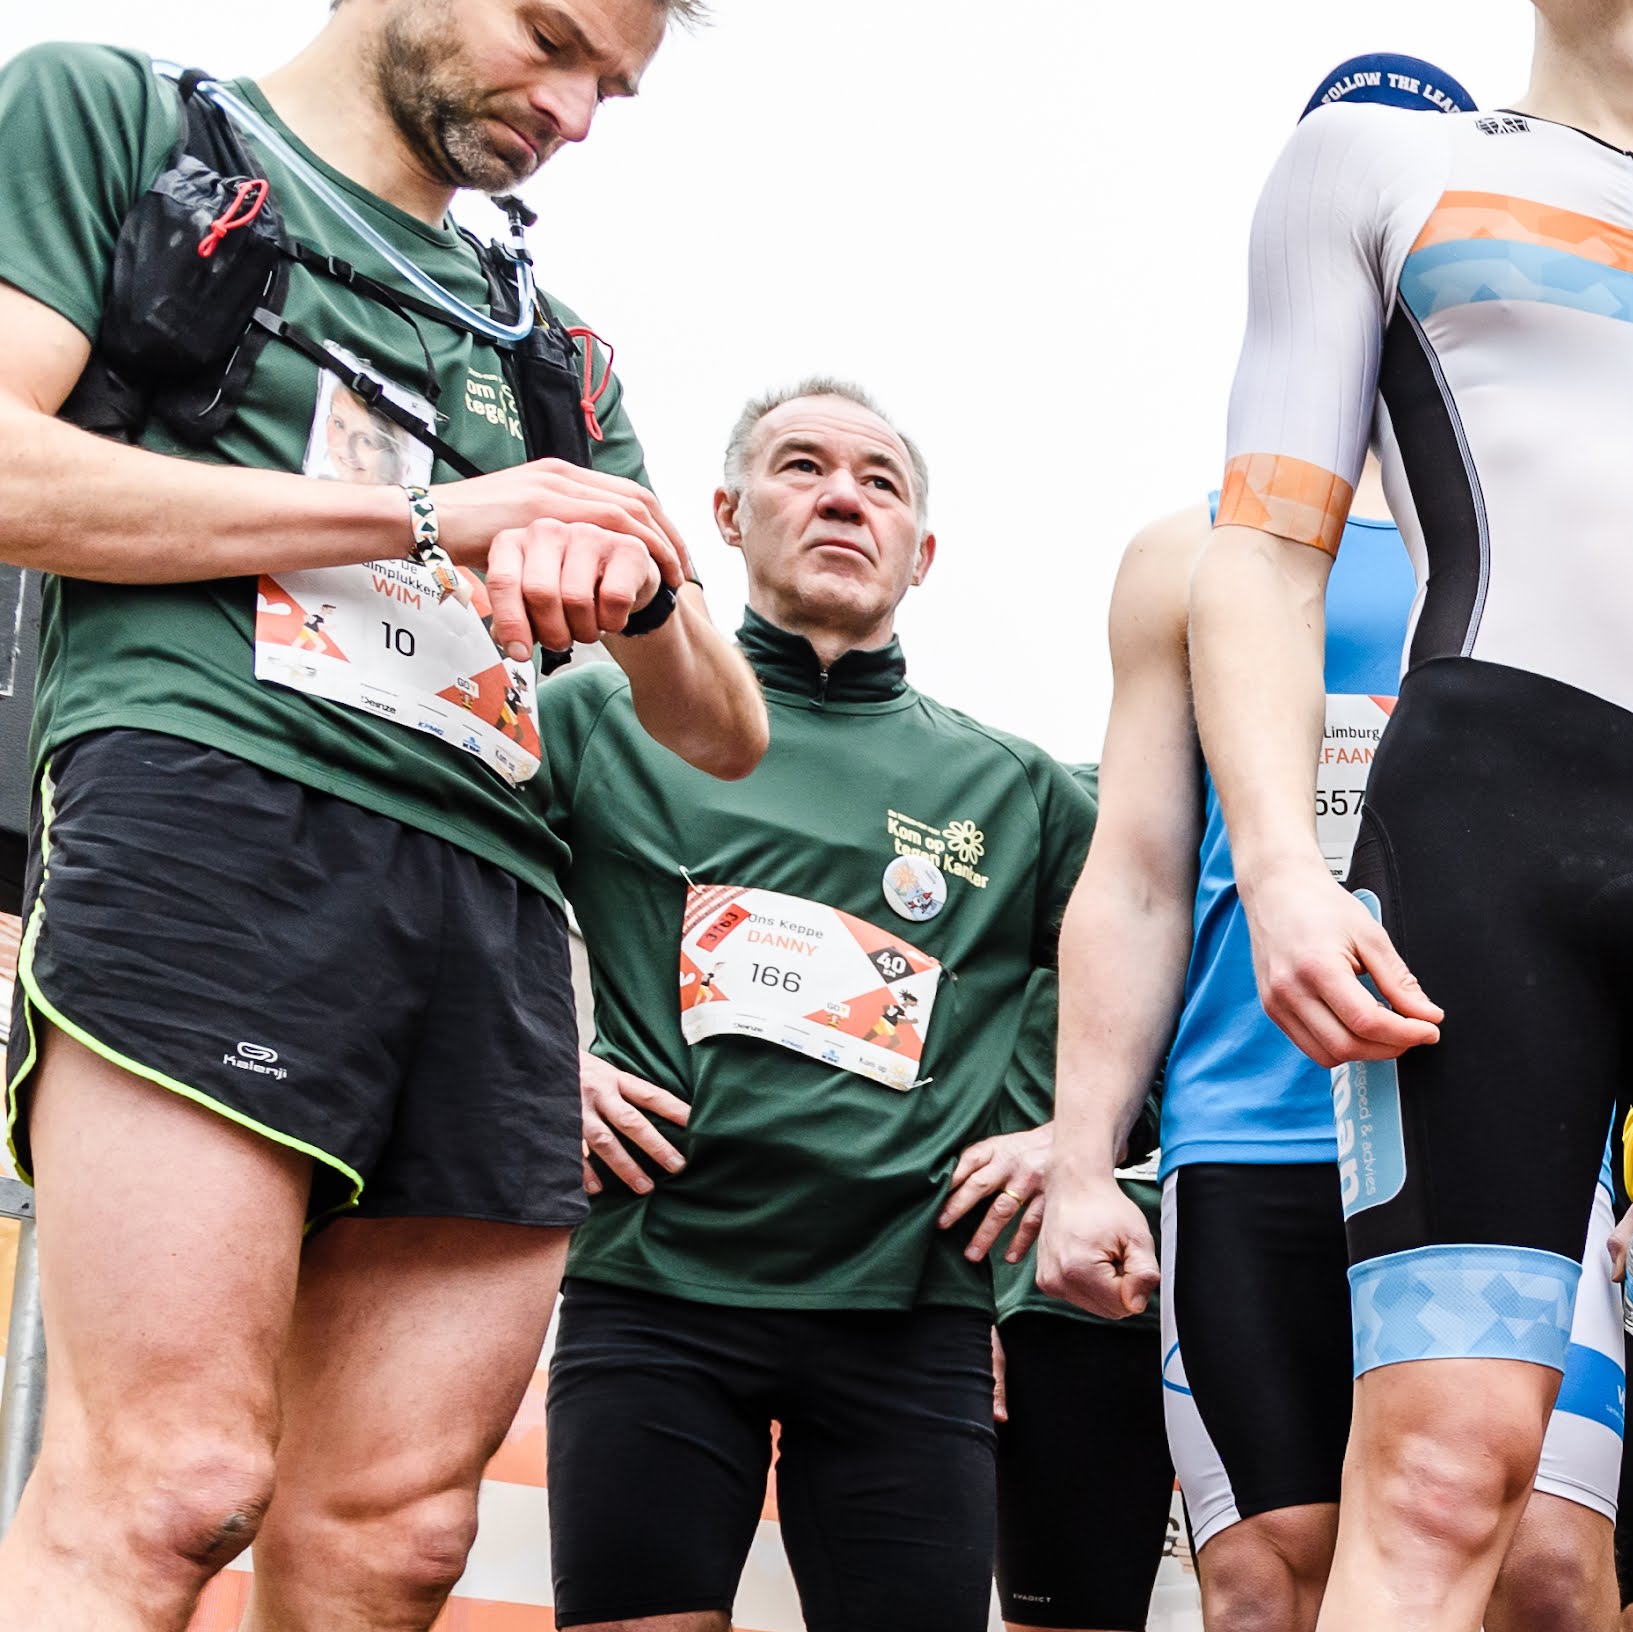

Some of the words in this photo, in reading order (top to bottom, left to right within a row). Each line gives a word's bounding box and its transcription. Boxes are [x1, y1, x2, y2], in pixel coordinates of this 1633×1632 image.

[1387, 73, 1421, 94] THE
[372, 574, 421, 610] WIM
[381, 620, 415, 657] 10
[1324, 726, 1379, 741] Limburg
[1316, 790, 1366, 816] 557
[887, 817, 922, 846] Kom
[924, 837, 946, 854] op
[943, 853, 990, 889] Kanker
[748, 913, 775, 926] Ons
[779, 919, 824, 940] Keppe
[747, 929, 820, 957] DANNY
[875, 951, 907, 975] 40
[751, 963, 802, 994] 166
[223, 1053, 288, 1080] Kalenji
[1362, 1141, 1377, 1197] advies
